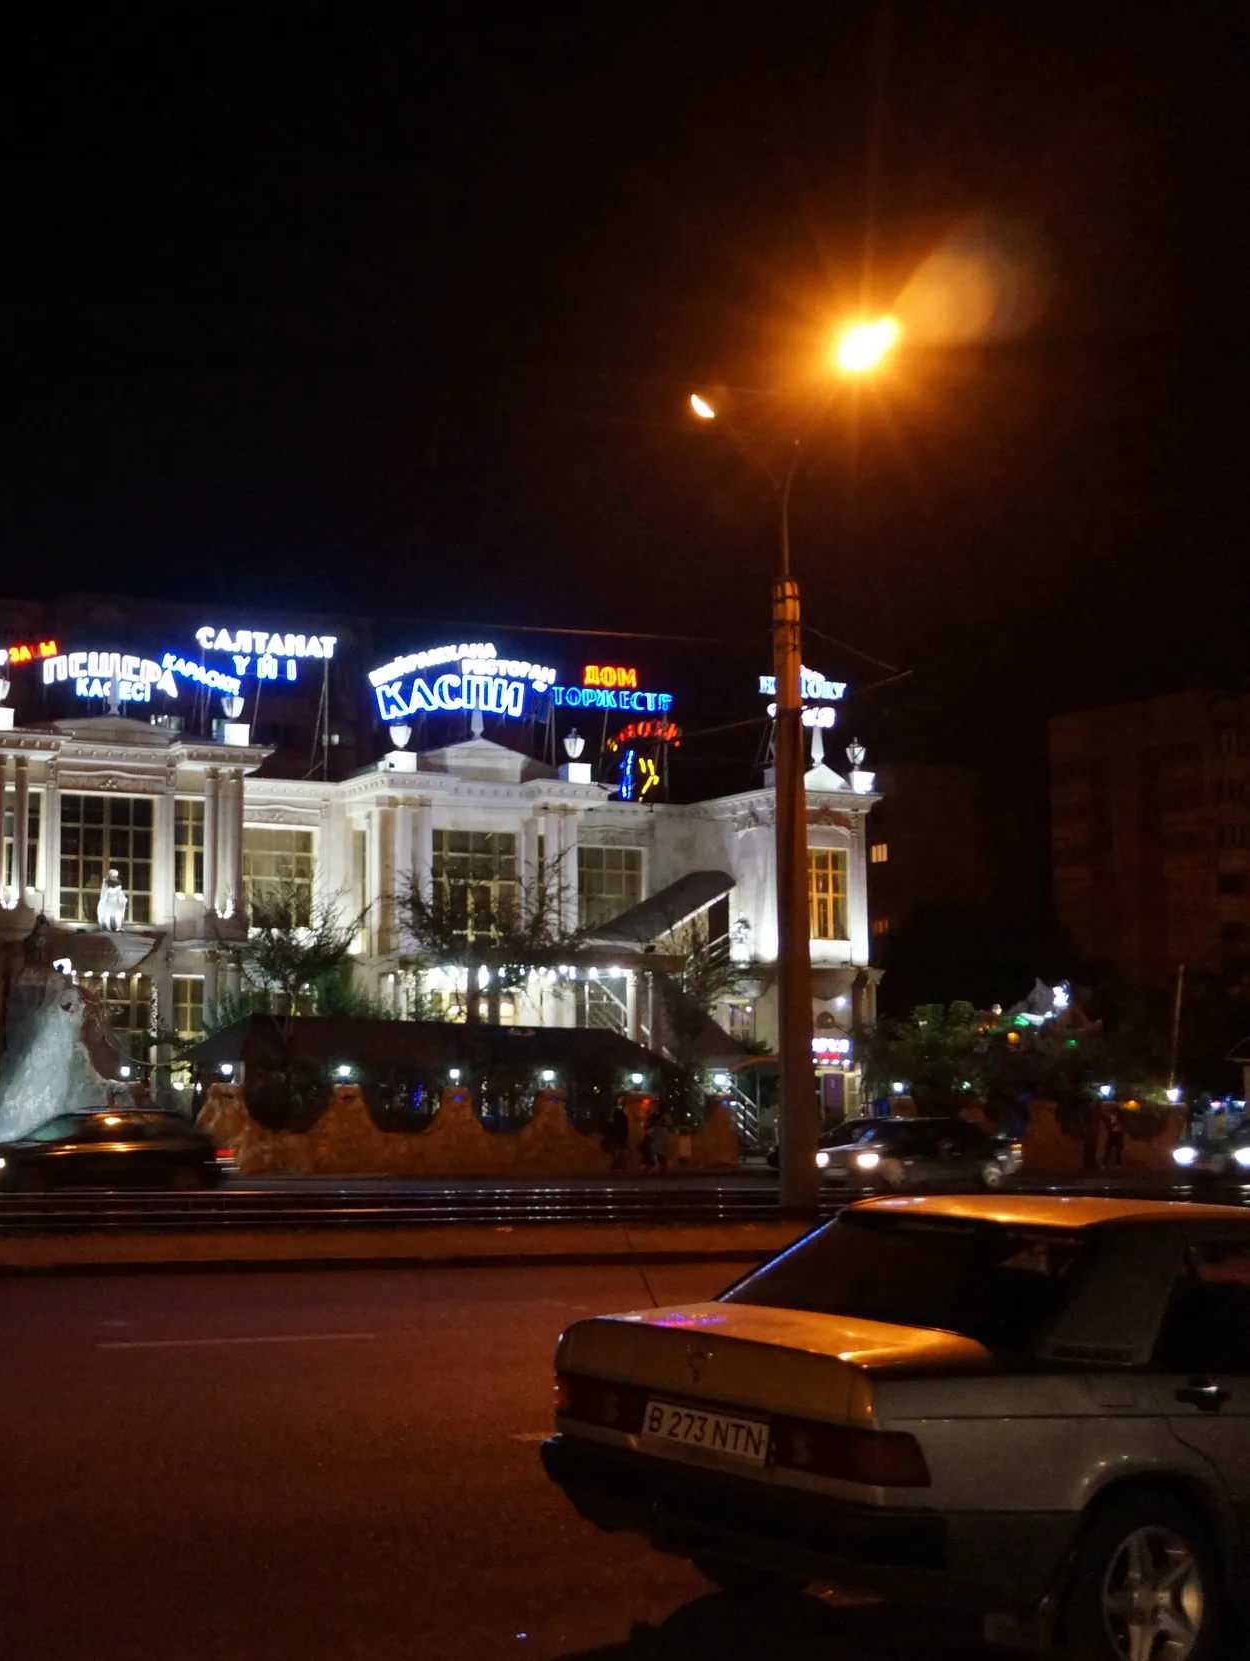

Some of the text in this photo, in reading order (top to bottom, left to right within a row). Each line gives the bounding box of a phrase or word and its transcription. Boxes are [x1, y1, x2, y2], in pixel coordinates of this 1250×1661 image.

[196, 626, 338, 659] САЛТАНАТ
[43, 651, 179, 699] ПЕЩЕРА
[162, 652, 241, 696] КАРАОКЕ
[461, 658, 557, 685] РЕСТОРАН
[584, 664, 638, 688] ДОМ
[758, 675, 847, 700] HTORY
[648, 1407, 763, 1455] B 273 NTN
